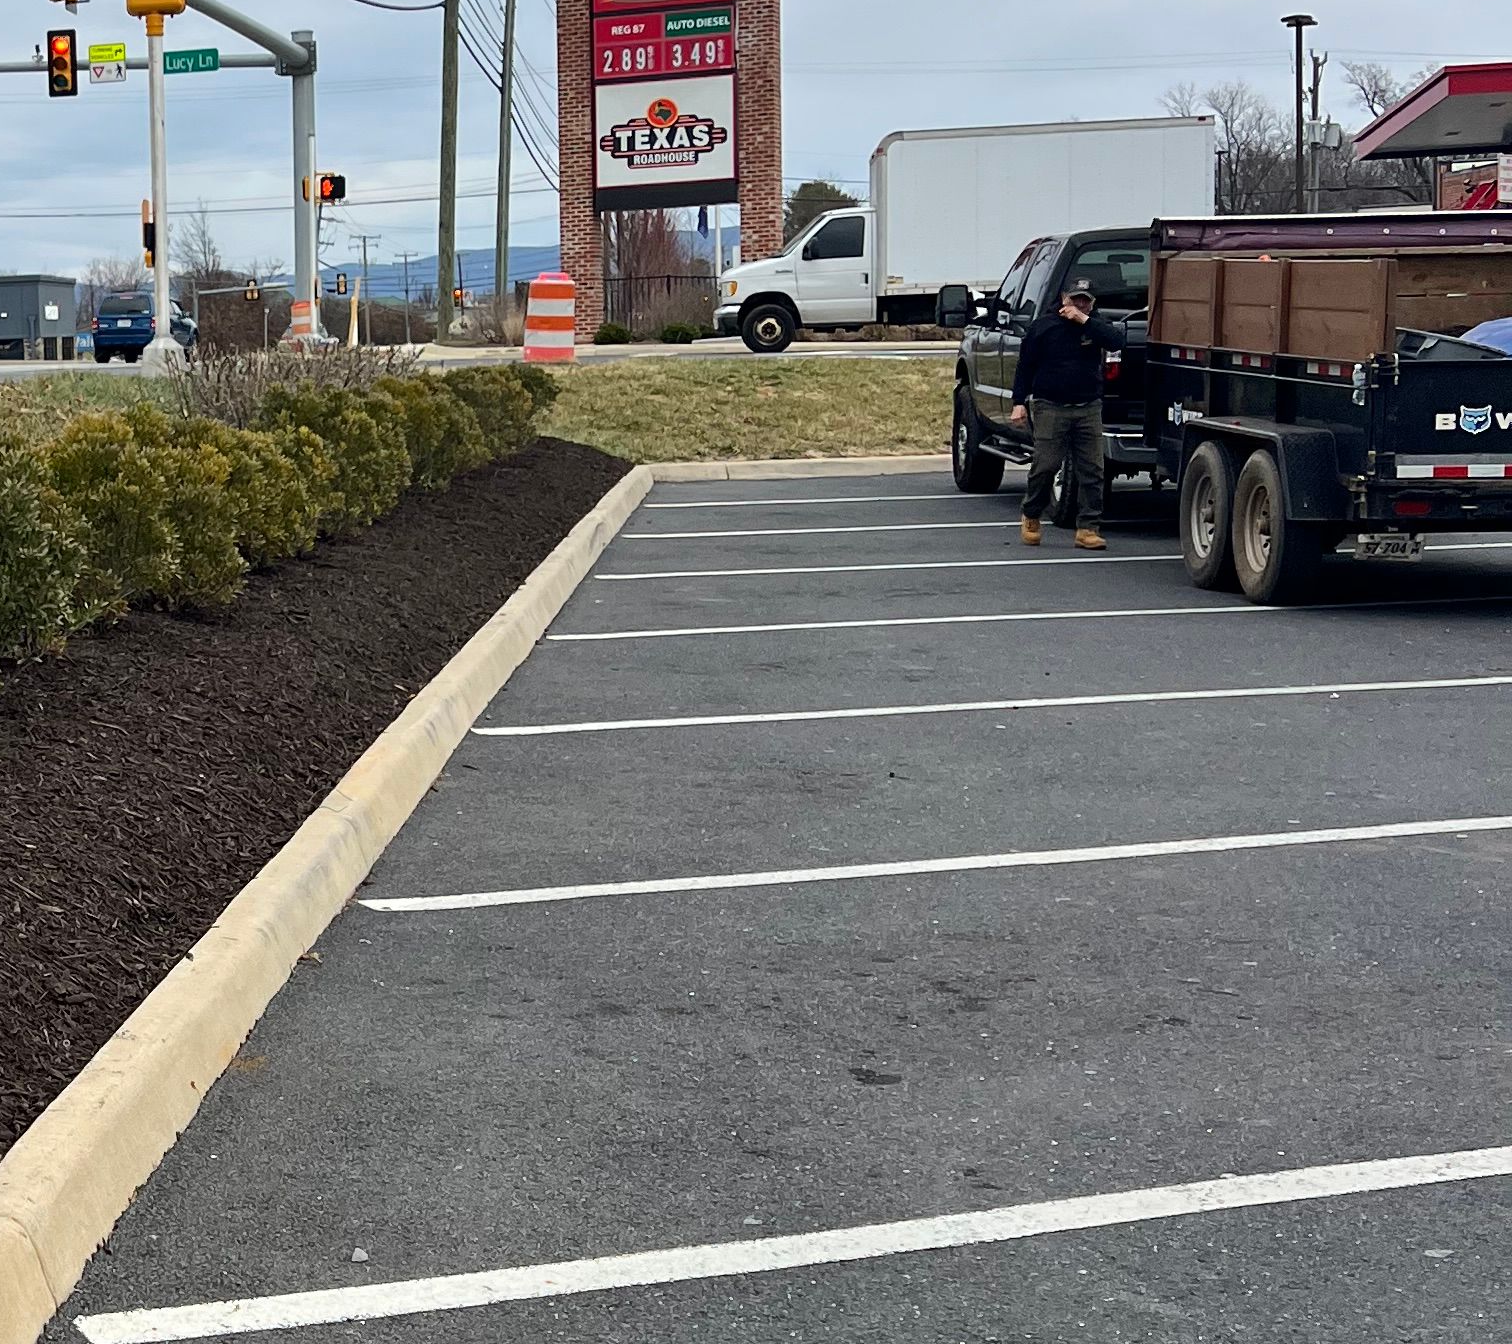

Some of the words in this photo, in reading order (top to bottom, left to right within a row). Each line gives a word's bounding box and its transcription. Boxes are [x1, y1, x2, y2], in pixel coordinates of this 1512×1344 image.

[611, 25, 631, 36] REG
[632, 24, 646, 35] 87
[667, 19, 695, 31] AUTO
[696, 16, 731, 28] DIESEL
[165, 55, 194, 72] Lucy
[199, 53, 213, 68] Ln
[615, 124, 710, 152] TEXAS
[633, 151, 696, 165] ROADHOUSE
